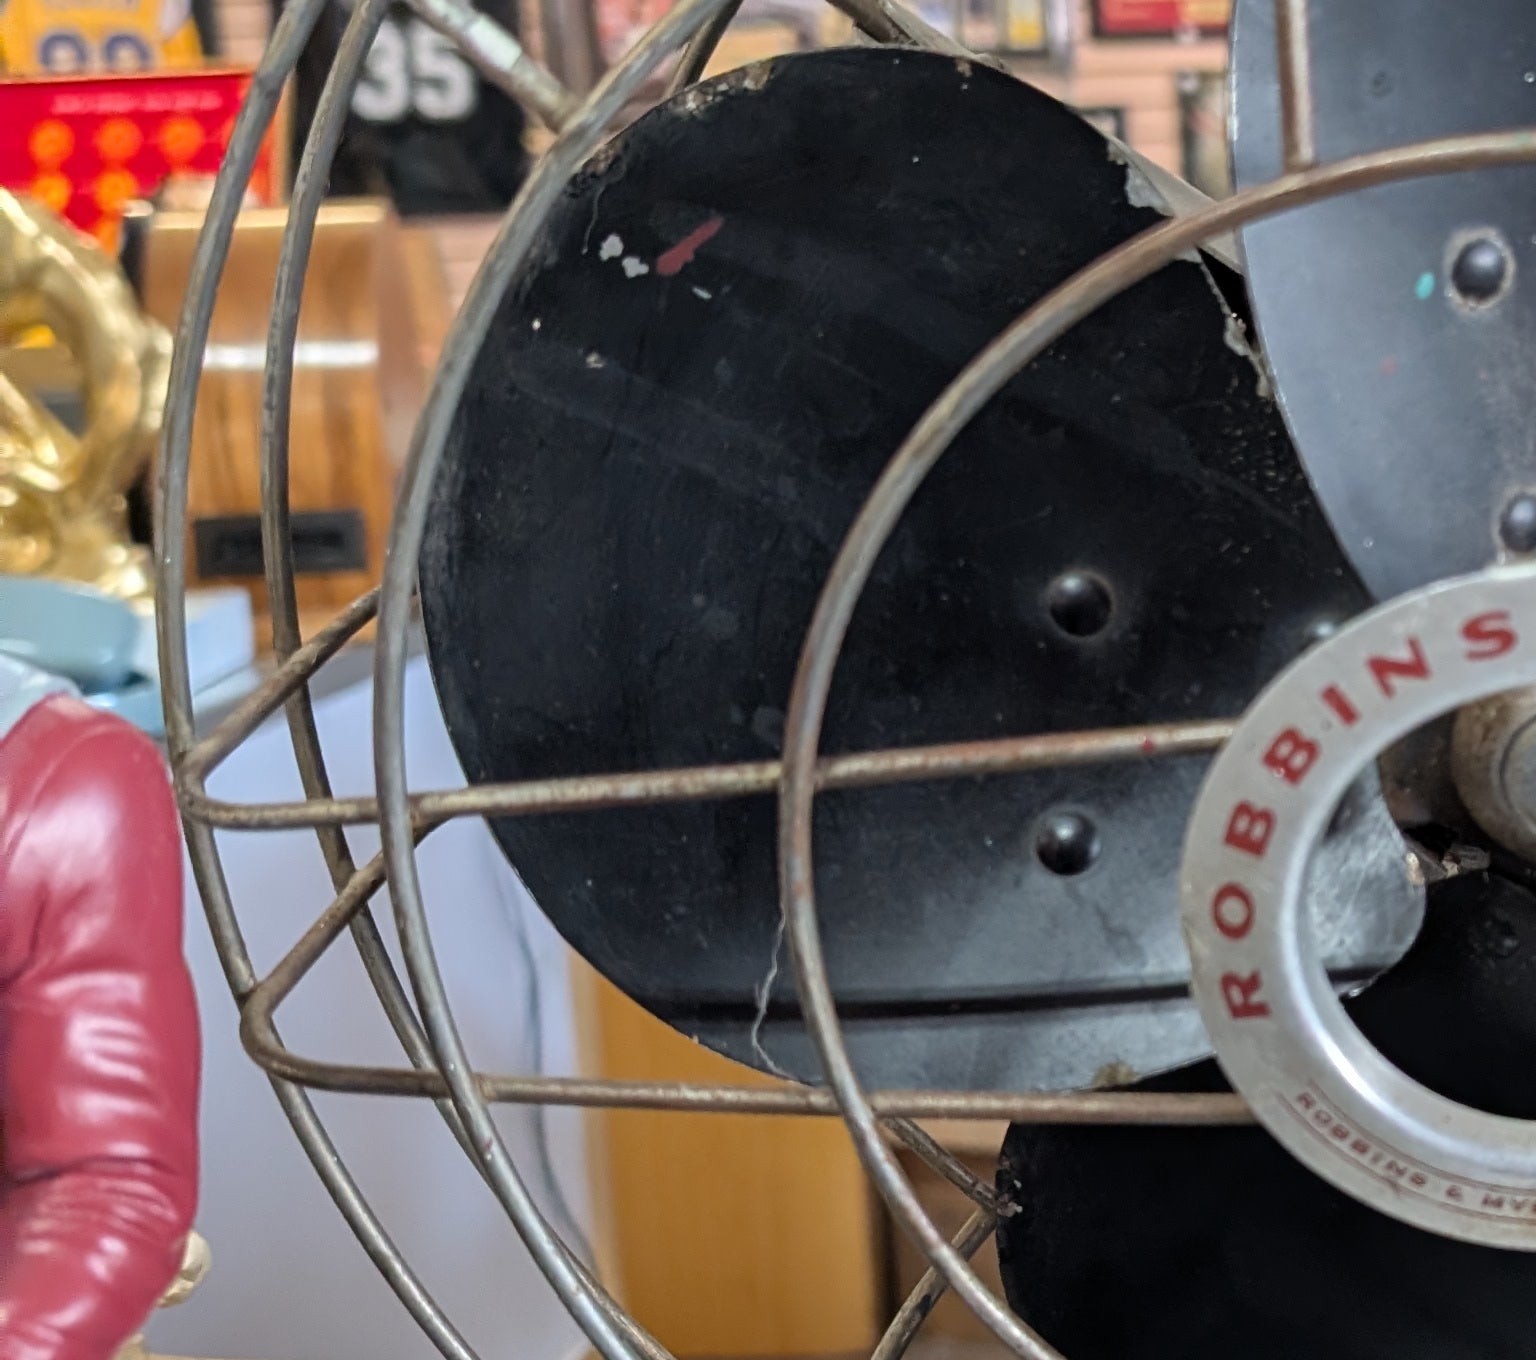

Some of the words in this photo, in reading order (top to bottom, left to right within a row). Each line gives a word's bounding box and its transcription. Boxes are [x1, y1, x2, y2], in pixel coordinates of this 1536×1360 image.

[351, 18, 476, 121] 35
[1213, 610, 1520, 1021] ROBBINS
[1297, 1091, 1427, 1187] ROBBINS
